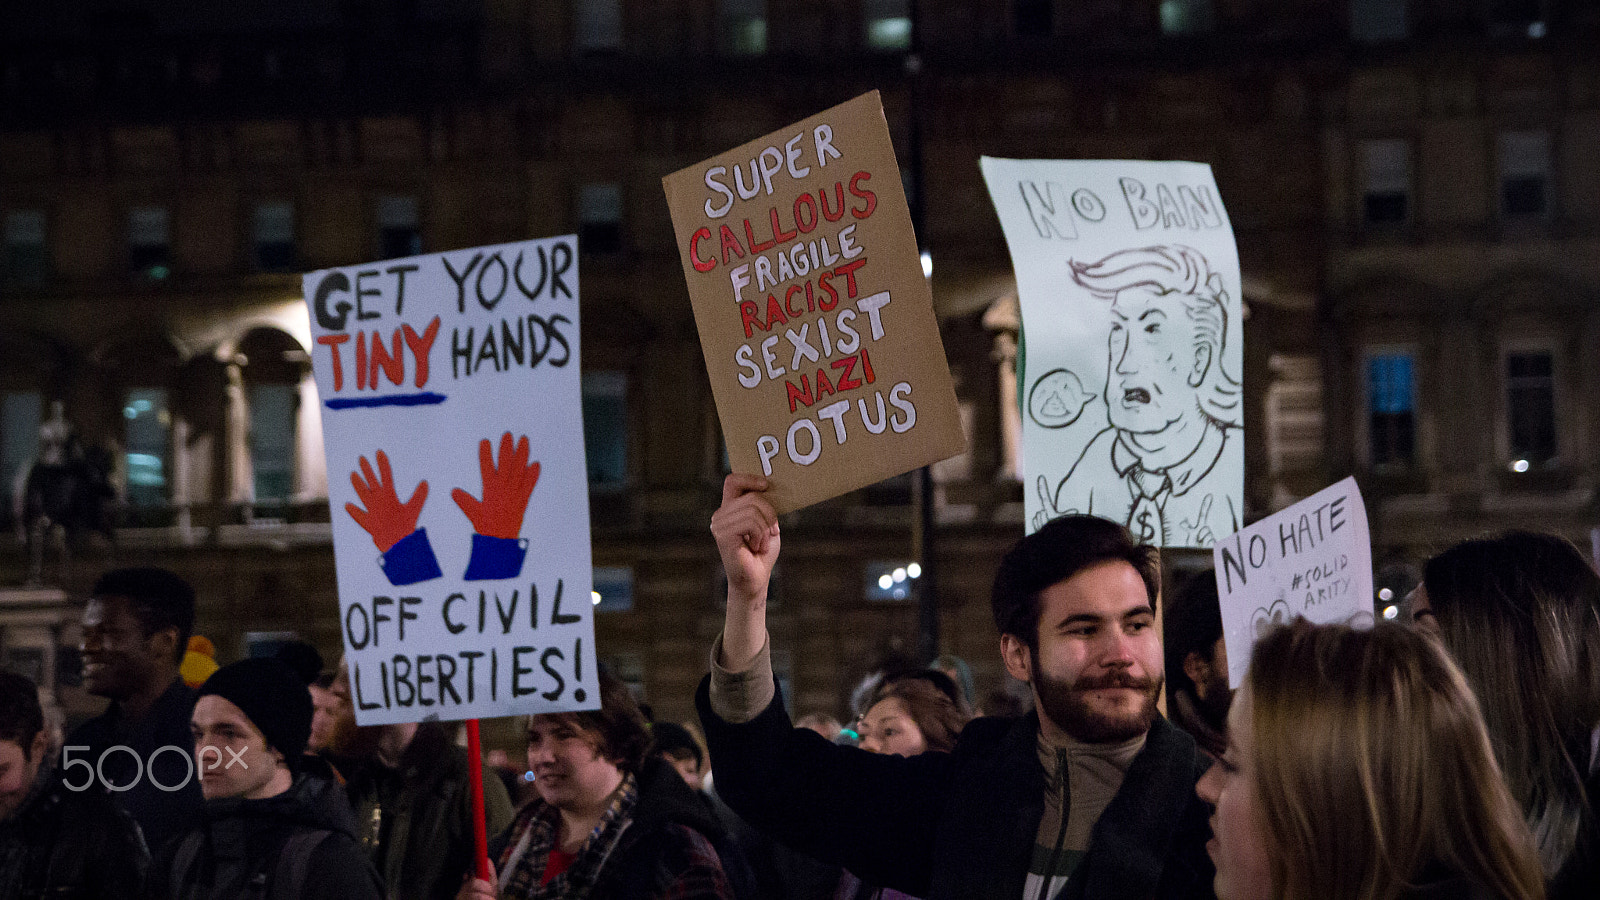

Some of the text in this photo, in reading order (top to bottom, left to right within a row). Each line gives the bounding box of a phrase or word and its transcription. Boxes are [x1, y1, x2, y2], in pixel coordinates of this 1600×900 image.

[704, 124, 843, 219] SUPER
[1019, 176, 1223, 240] NO BAN
[690, 170, 878, 272] CALLOUS
[314, 241, 573, 331] GET YOUR
[729, 222, 864, 303] FRAGILE
[739, 257, 867, 338] RACIST
[317, 313, 573, 392] TINY HANDS
[735, 290, 892, 389] SEXIST
[785, 348, 876, 414] NAZI
[756, 381, 917, 478] POTUS
[1221, 495, 1347, 594] NO HATE
[1291, 554, 1348, 591] #SOLID
[346, 578, 582, 650] OFF CIVIL
[1304, 577, 1350, 610] ARITY
[355, 637, 587, 710] LIBERTIES!
